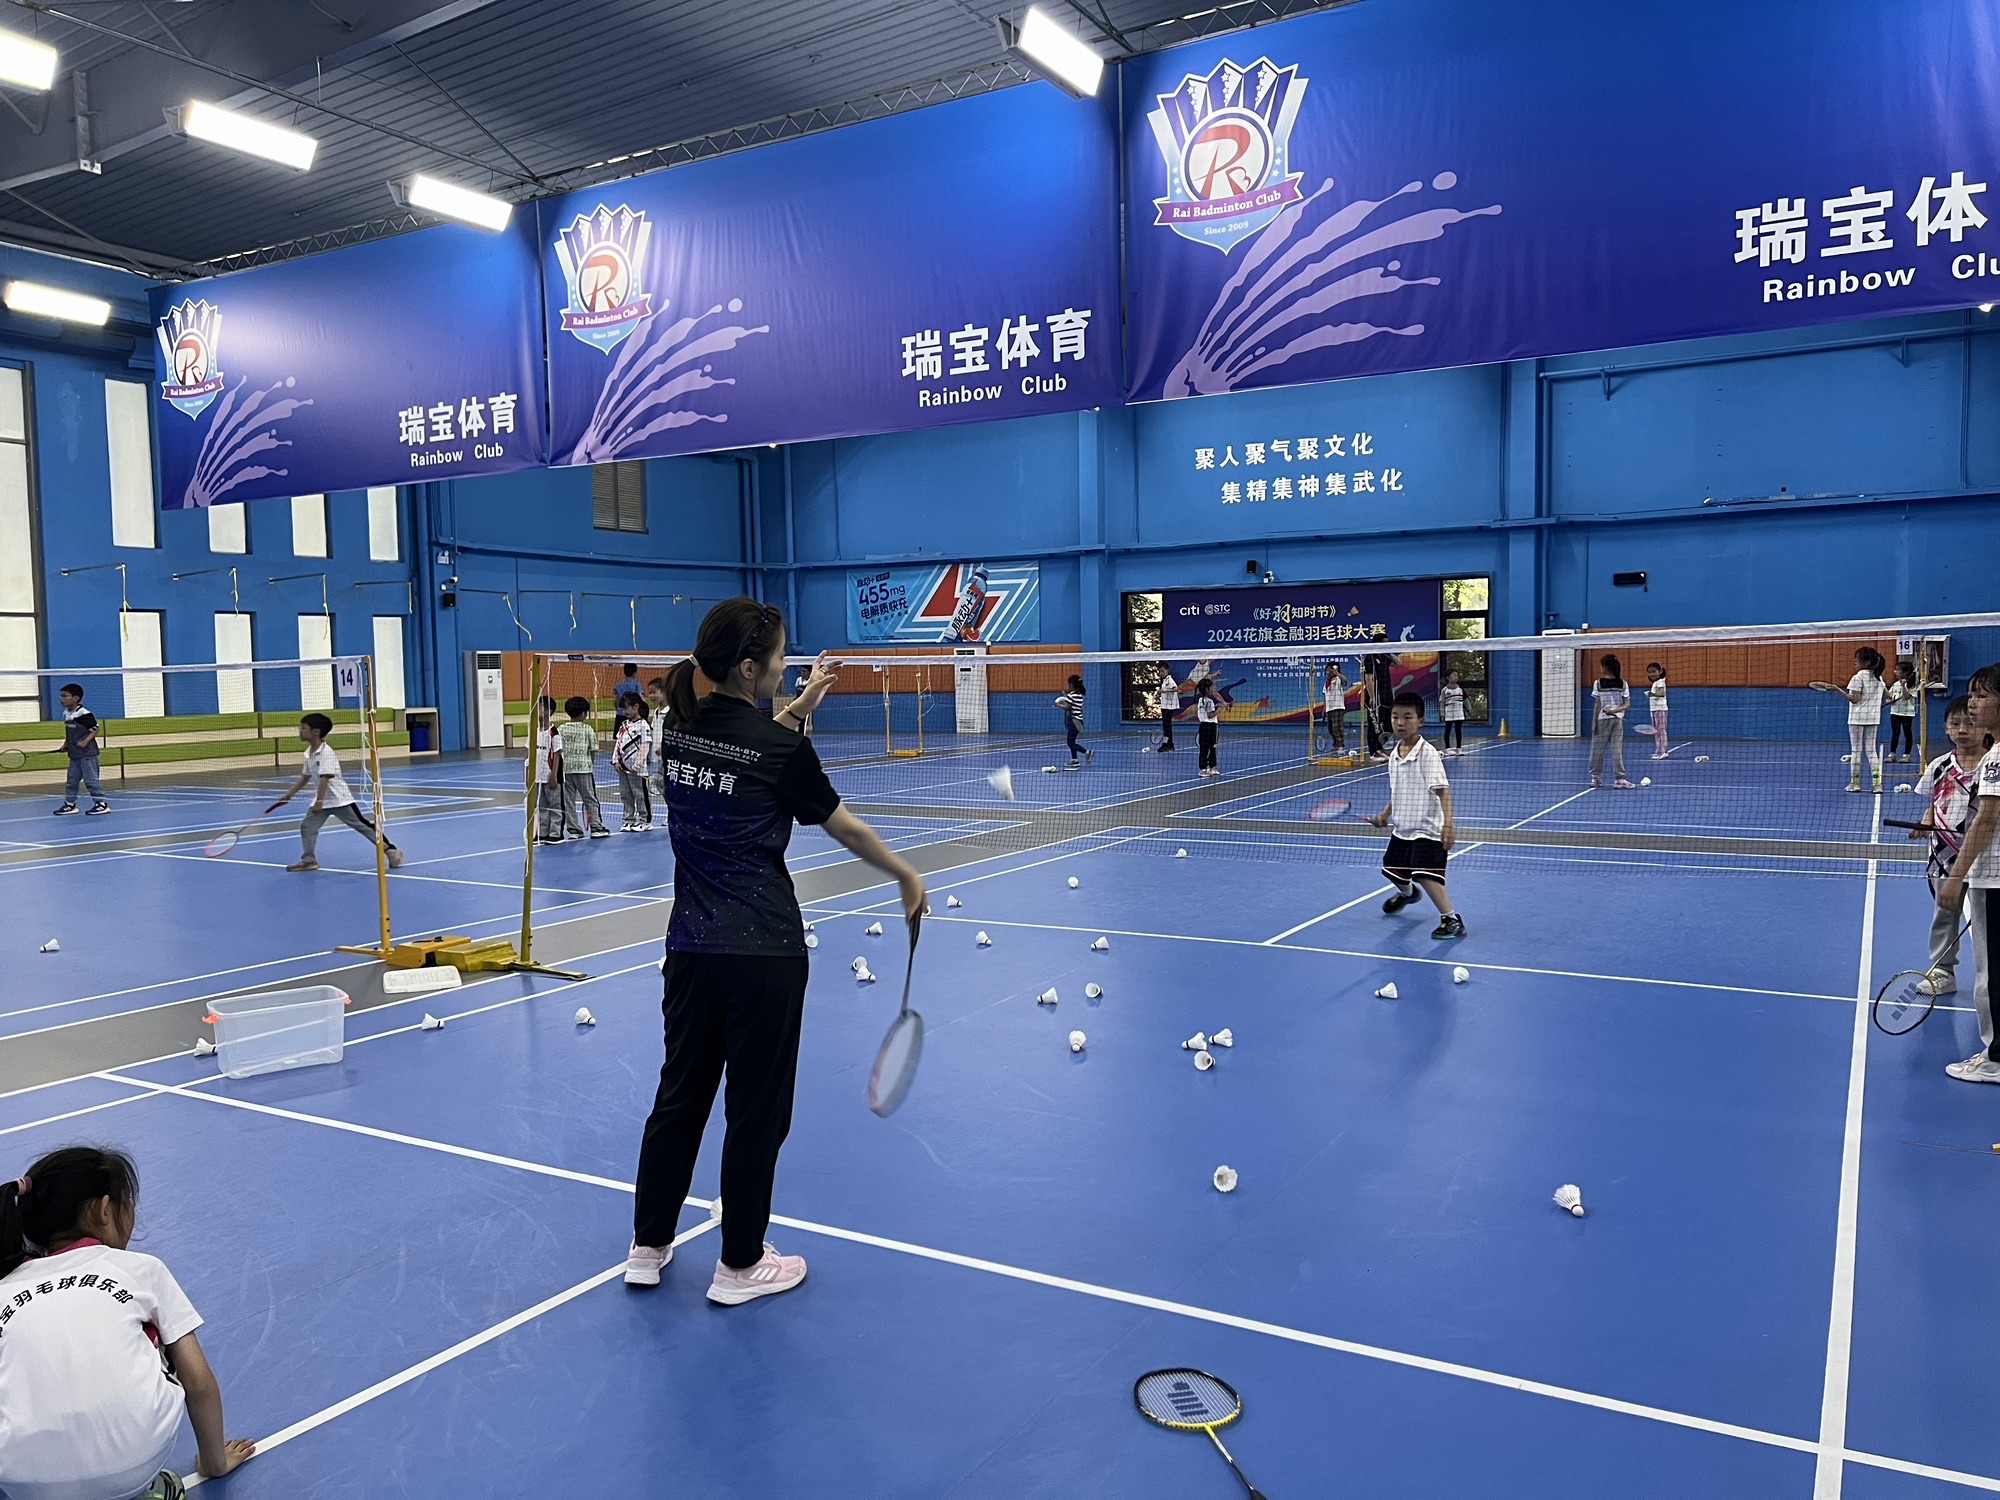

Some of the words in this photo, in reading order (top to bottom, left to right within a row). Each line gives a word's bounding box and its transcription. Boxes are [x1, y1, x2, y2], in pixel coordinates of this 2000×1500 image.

[1173, 207, 1191, 218] Rai
[1193, 200, 1253, 217] Badminton
[1255, 190, 1282, 206] Club
[1733, 171, 1989, 268] 瑞宝体
[1204, 226, 1226, 235] Since
[1227, 221, 1249, 232] 2009
[1763, 267, 1916, 303] Rainbow
[572, 316, 584, 326] Rai
[585, 313, 622, 325] Badminton
[622, 306, 639, 318] Club
[901, 308, 1092, 381] 瑞宝体育
[919, 385, 1003, 408] Rainbow
[1021, 373, 1067, 395] Club
[399, 392, 518, 446] 瑞宝体育
[410, 450, 463, 467] Rainbow
[474, 442, 504, 459] Club
[1195, 432, 1374, 470] 聚人聚气聚文化
[1221, 468, 1404, 505] 集精集神集武化
[861, 597, 909, 619] 电解质快充
[1179, 604, 1200, 616] citi
[1898, 640, 1910, 650] 16
[340, 668, 354, 686] 14
[667, 759, 738, 795] 瑞宝体育
[0, 1273, 134, 1338] 宝羽毛球俱乐部
